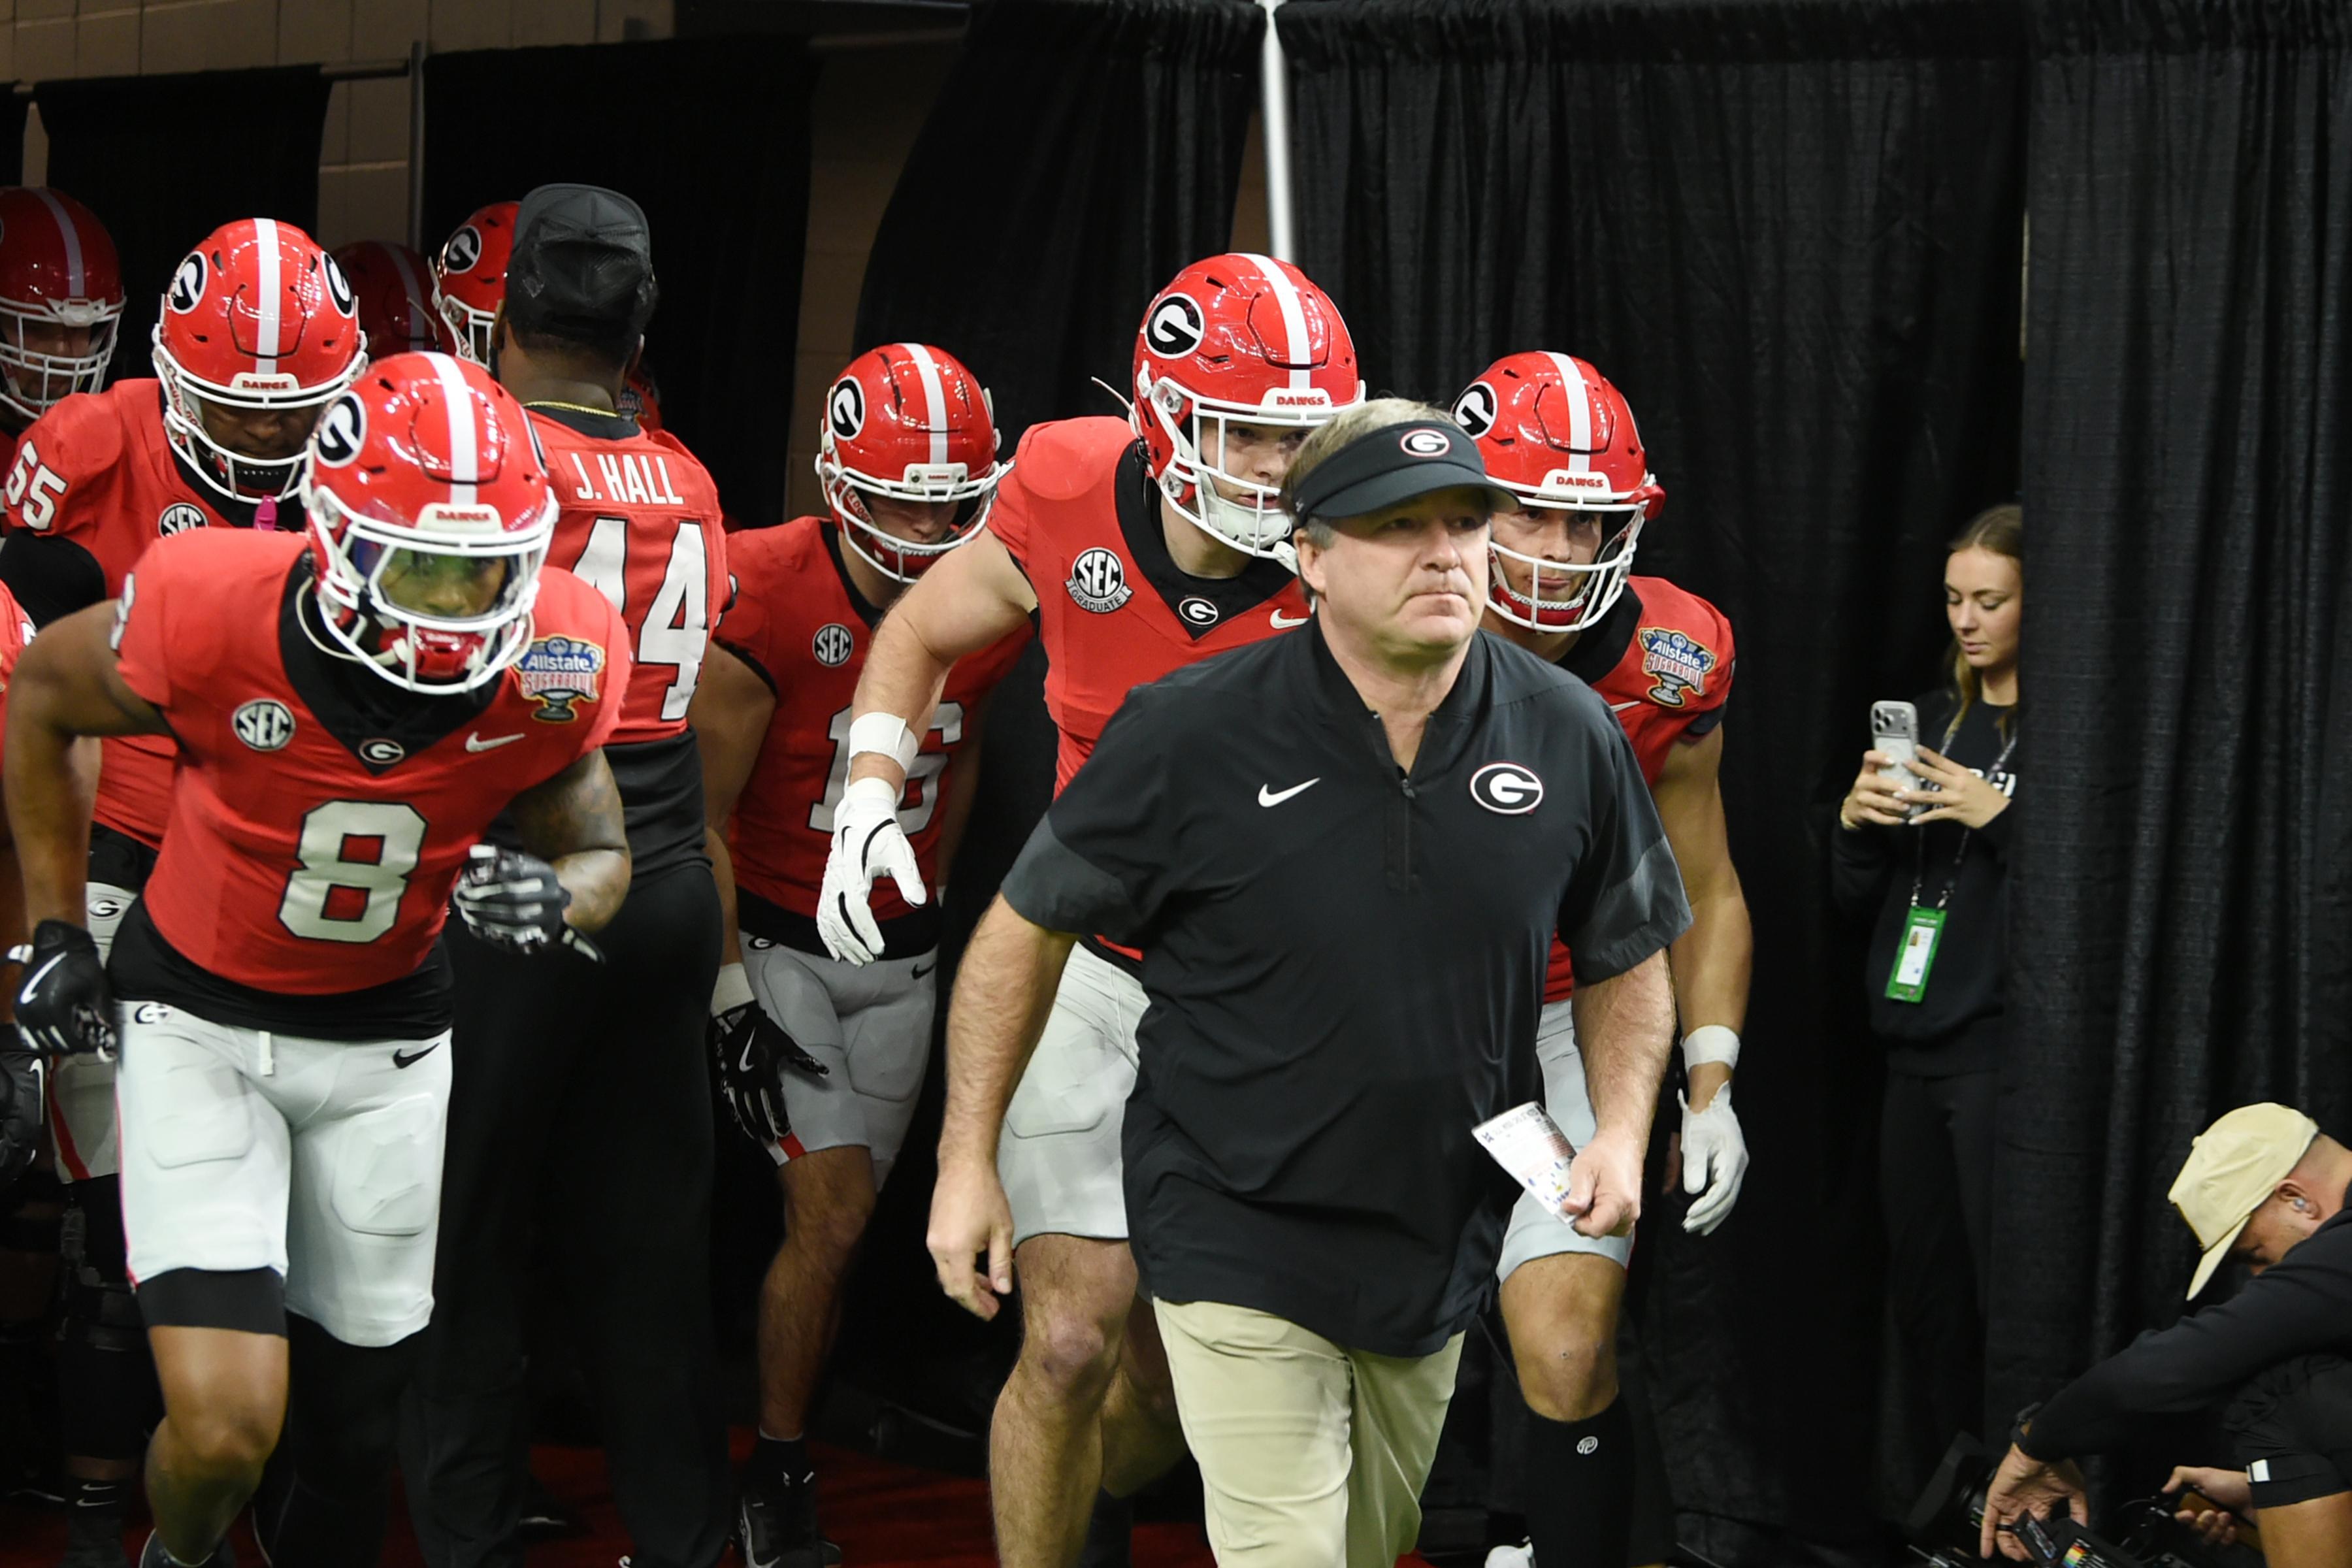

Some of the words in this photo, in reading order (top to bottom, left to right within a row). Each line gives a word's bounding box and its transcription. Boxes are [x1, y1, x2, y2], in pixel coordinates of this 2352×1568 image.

[1147, 295, 1202, 357] G
[242, 381, 289, 389] DAWGS
[1276, 395, 1325, 406] DAWGS
[830, 377, 863, 439] G
[1452, 383, 1495, 438] G
[317, 393, 365, 465] G
[1402, 431, 1448, 455] G
[5, 439, 67, 531] 65
[1556, 476, 1604, 488] DAWGS
[1075, 549, 1120, 598] SEC
[1071, 589, 1122, 612] GRADUATE
[1179, 598, 1218, 624] G
[525, 654, 593, 672] Allstate
[814, 625, 851, 664] SEC
[1644, 640, 1702, 670] Allstate
[237, 702, 291, 749] SEC
[361, 740, 404, 763] G
[1471, 764, 1543, 813] G
[277, 798, 429, 943] 8
